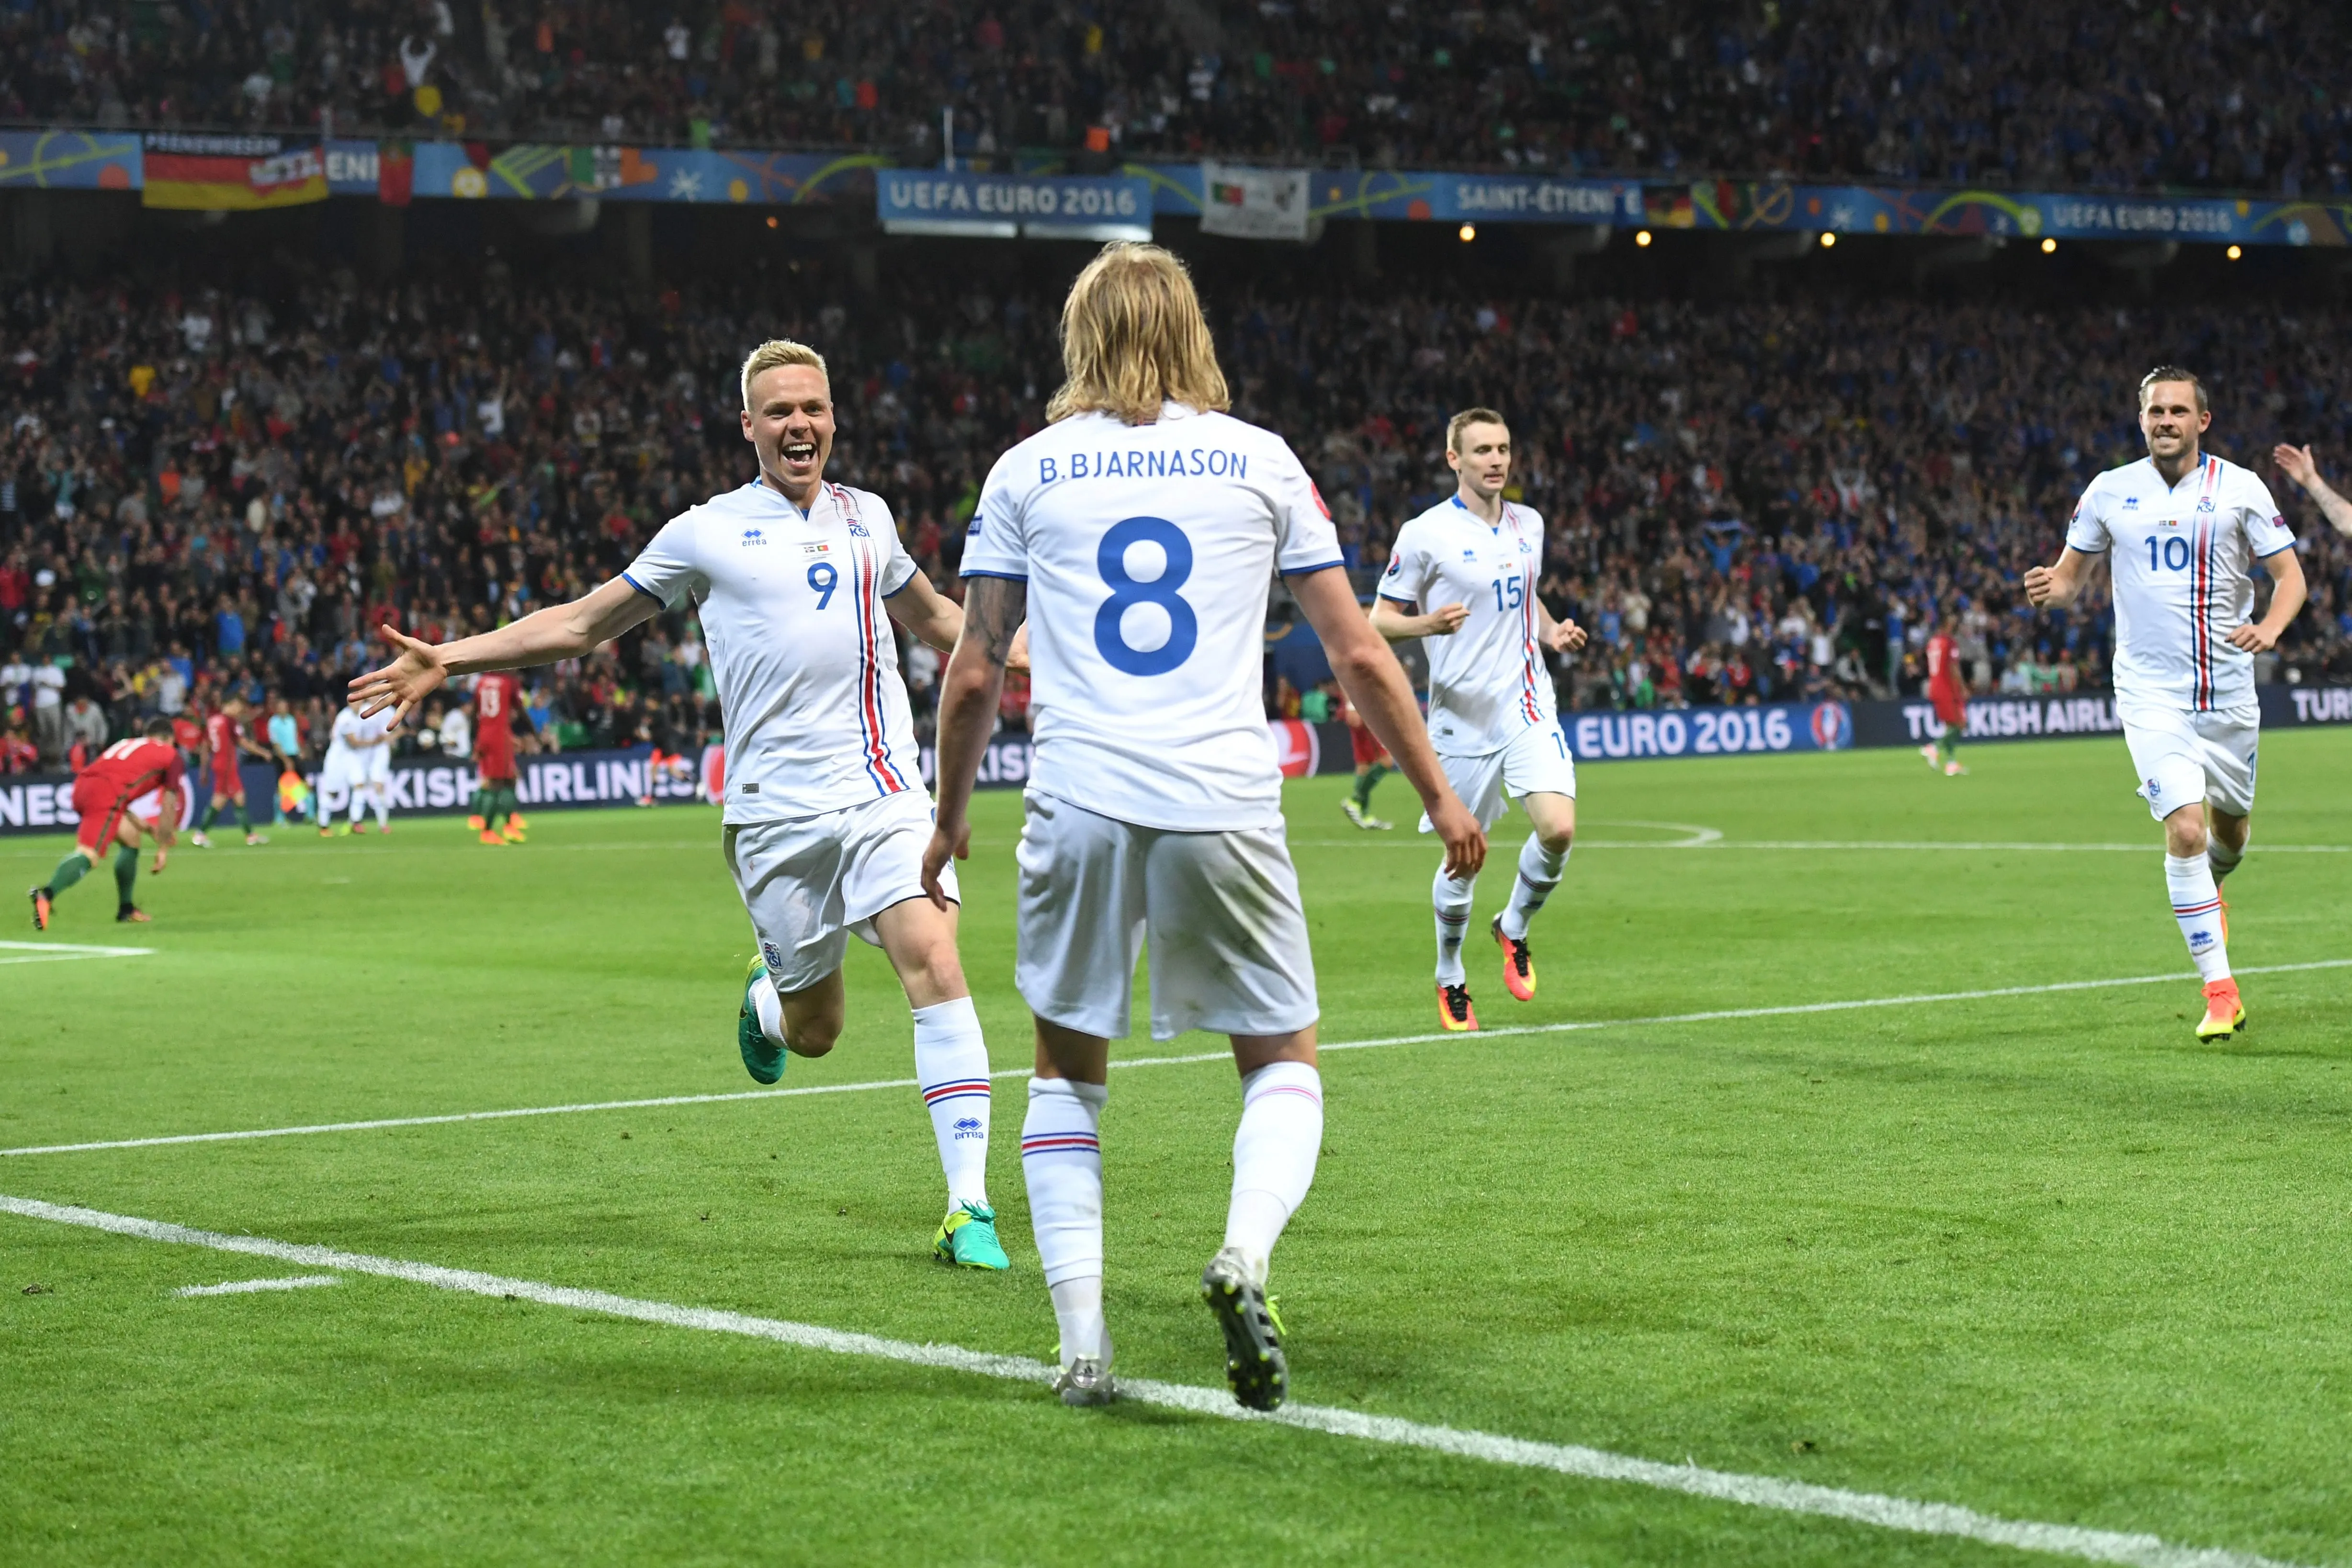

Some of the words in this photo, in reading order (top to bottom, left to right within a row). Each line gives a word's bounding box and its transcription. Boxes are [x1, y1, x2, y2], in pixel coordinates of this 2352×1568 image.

[890, 180, 970, 211] UEFA
[976, 183, 1058, 214] EURO
[1063, 186, 1137, 216] 2016
[2053, 203, 2113, 229] UEFA
[2115, 204, 2176, 231] EURO
[2178, 206, 2232, 233] 2016
[1040, 449, 1247, 484] B.BJARNASON
[2145, 535, 2189, 572] 10
[807, 562, 838, 610] 9
[1095, 516, 1197, 677] 8
[1492, 576, 1522, 612] 15
[1576, 712, 1687, 757] EURO
[1693, 709, 1792, 753] 2016
